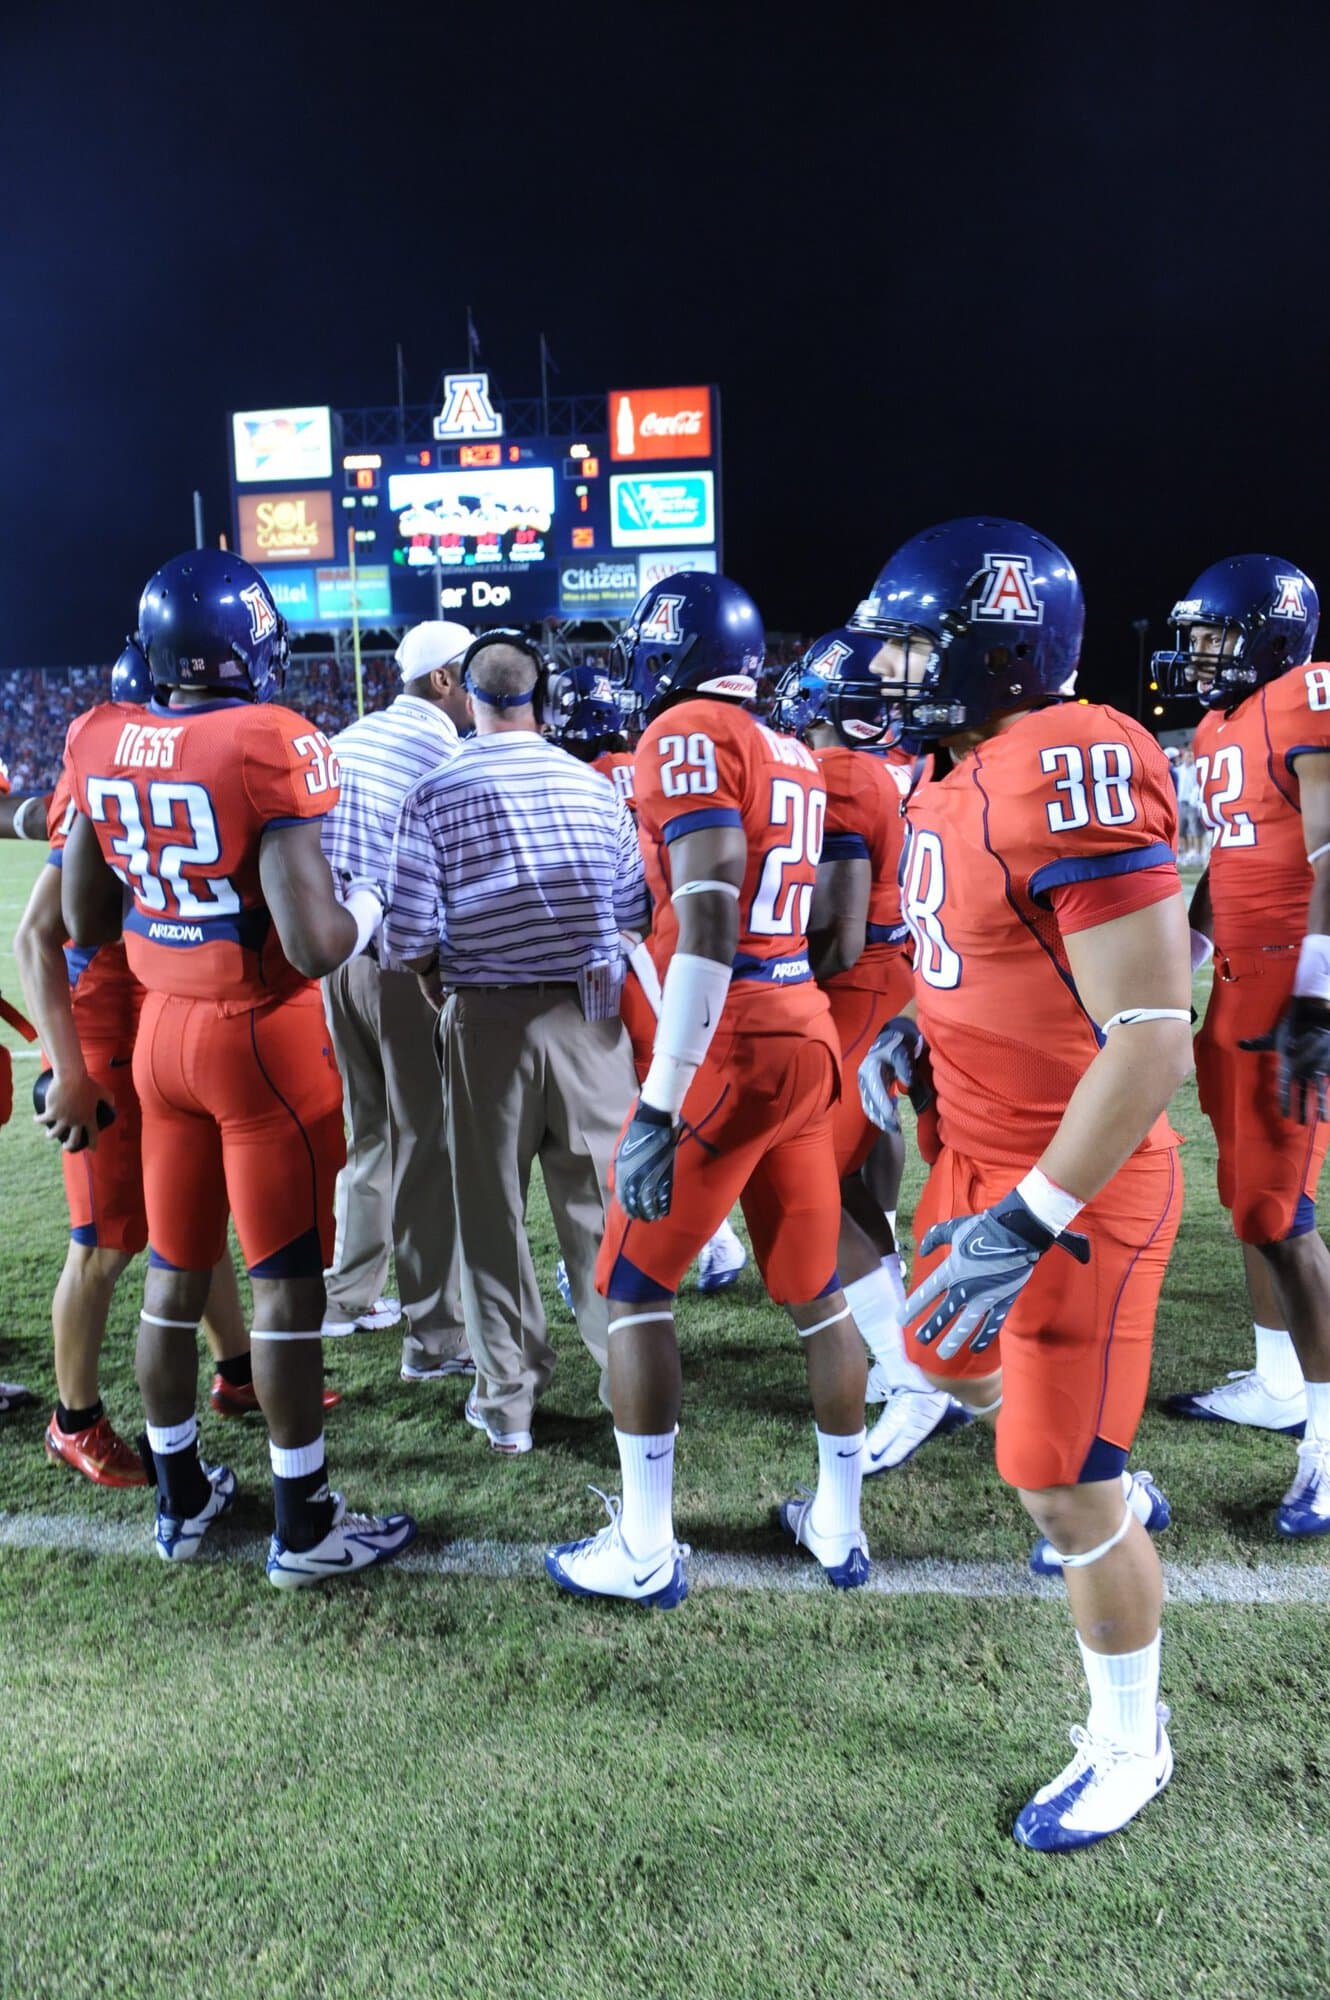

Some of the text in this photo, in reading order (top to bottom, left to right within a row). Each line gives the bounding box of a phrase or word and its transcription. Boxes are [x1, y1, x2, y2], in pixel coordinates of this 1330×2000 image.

[434, 374, 503, 440] A
[562, 568, 637, 590] Citizen
[971, 554, 1044, 624] A
[1269, 575, 1307, 621] A
[240, 581, 277, 644] A
[640, 594, 686, 644] A
[191, 657, 206, 672] 32
[812, 640, 854, 682] A
[113, 722, 184, 768] NESS
[293, 731, 340, 795] 32
[658, 732, 719, 798] 29
[611, 764, 636, 800] 8
[1040, 743, 1138, 833] 38
[85, 776, 241, 918] 32
[148, 922, 204, 943] ARIZONA
[899, 828, 963, 991] 8
